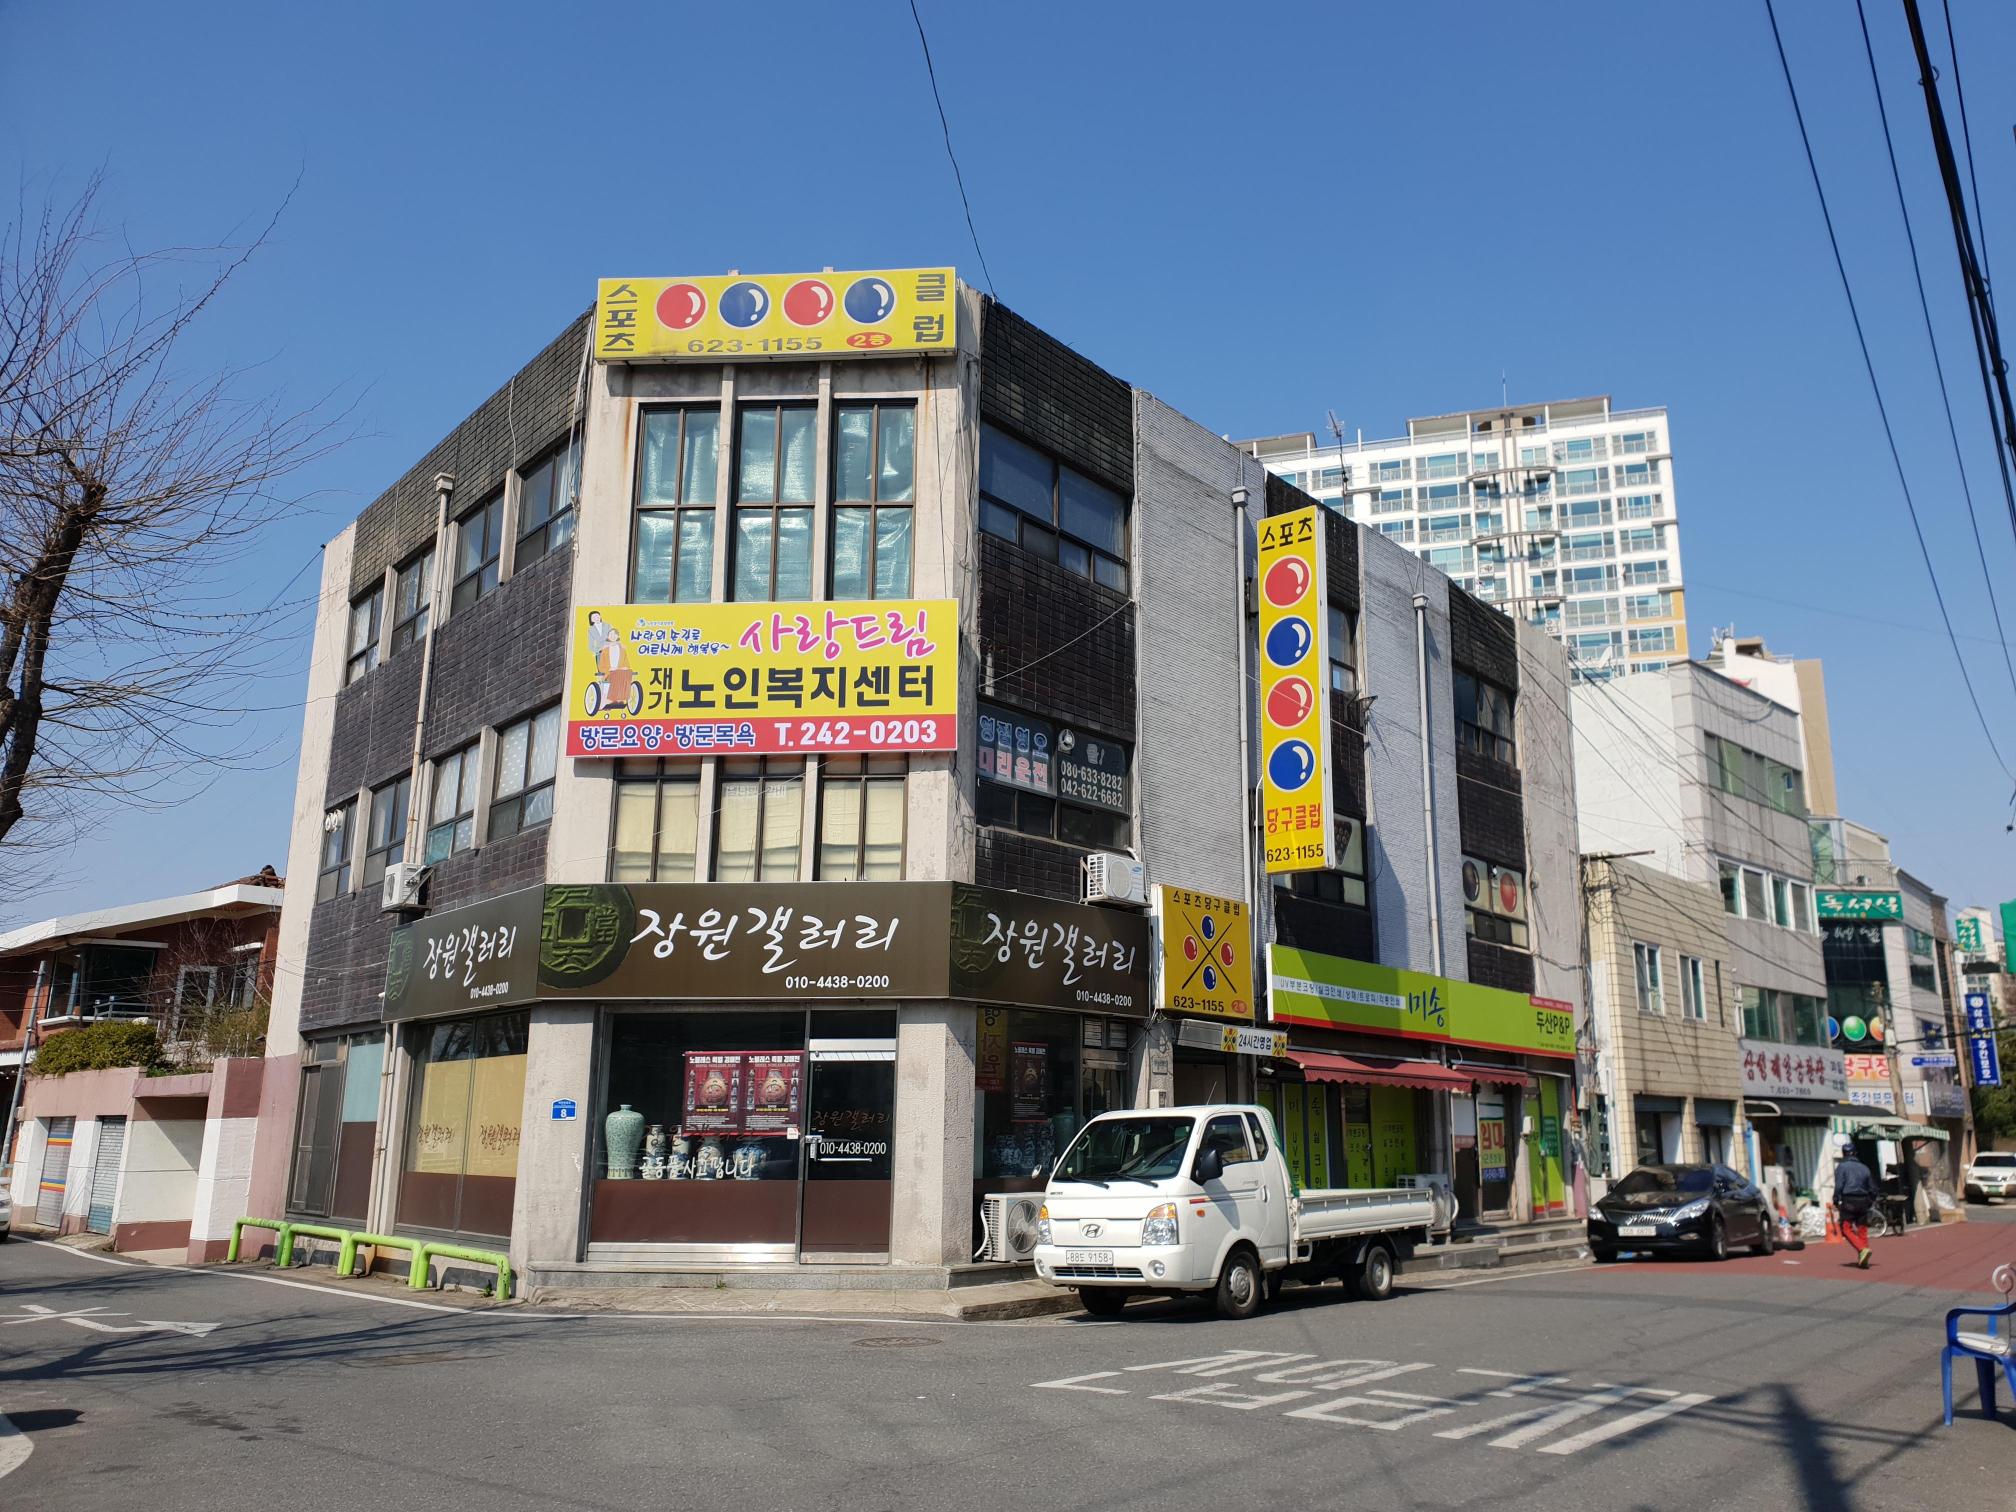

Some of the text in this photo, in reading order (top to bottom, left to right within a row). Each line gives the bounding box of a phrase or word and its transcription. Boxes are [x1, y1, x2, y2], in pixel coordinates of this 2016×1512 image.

[602, 283, 638, 352] 스포츠
[912, 273, 947, 343] 클럽
[687, 336, 823, 353] 623-1155
[852, 333, 887, 348] 2층
[1260, 516, 1313, 553] 스포츠
[738, 609, 936, 660] 사랑드림
[678, 664, 935, 710] 노인복지센터
[1060, 760, 1123, 791] 080-633-8282
[1060, 778, 1123, 808] 042-622-6682
[1266, 802, 1322, 835] 당구클럽
[1266, 843, 1324, 863] 623-1155
[629, 904, 900, 974] 장원갤러리
[982, 912, 1136, 986] 장원갤러리
[423, 924, 517, 987] 장원갤러리
[470, 981, 509, 999] 010-4438-0200
[785, 975, 890, 990] 010-4438-0200
[1076, 989, 1133, 1008] 010-4438-0200
[1173, 995, 1225, 1013] 623-1155
[1408, 987, 1447, 1028] 미송
[1536, 1011, 1570, 1035] 두산P&P
[1238, 1032, 1273, 1051] 24시간영업
[560, 1108, 567, 1118] 8
[819, 1142, 887, 1155] 010-4438-0200
[1088, 1252, 1109, 1262] 9158
